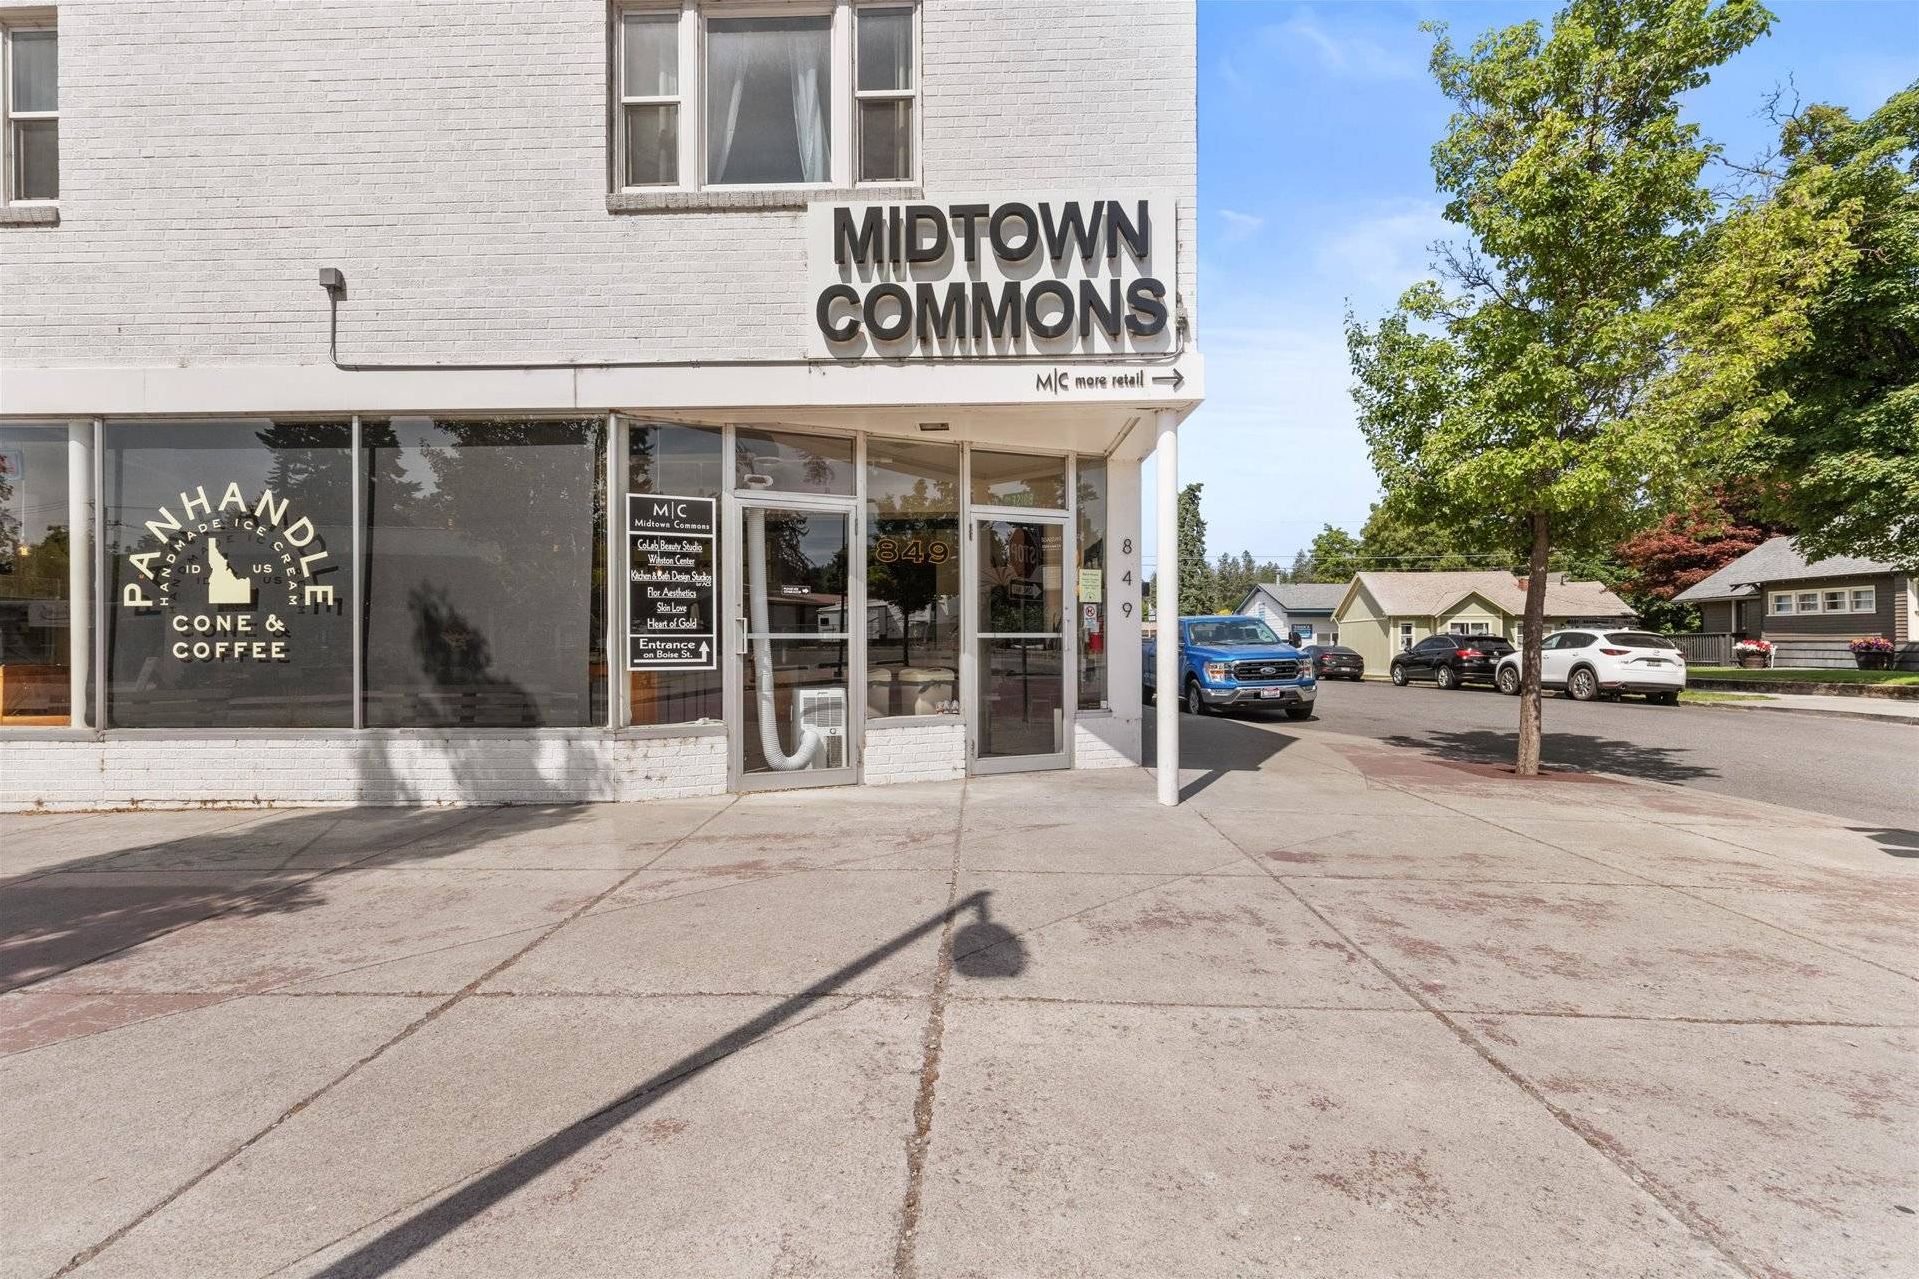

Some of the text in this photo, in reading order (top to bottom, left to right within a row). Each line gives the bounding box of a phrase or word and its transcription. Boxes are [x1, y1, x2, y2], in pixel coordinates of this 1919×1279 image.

[833, 200, 1149, 264] MIDTOWN
[815, 277, 1168, 341] COMMONS
[1075, 376, 1107, 389] more
[1112, 369, 1144, 388] retail
[634, 519, 710, 530] Midtown Commons
[123, 482, 334, 607] PANHANDLE
[637, 539, 703, 552] CoLab Beauty Studio
[876, 539, 950, 564] 849
[160, 518, 298, 606] HANDMADE ICE CREAM
[675, 555, 695, 565] Center
[185, 564, 273, 574] ID US
[631, 569, 652, 580] Kitchen
[652, 571, 657, 580] &
[672, 571, 690, 582] Design
[691, 571, 712, 582] Studios
[647, 587, 697, 598] Flor Aesthetics
[657, 602, 687, 612] Skin Love
[172, 613, 286, 632] CONE &
[647, 618, 697, 628] Heart of Gold
[172, 642, 286, 658] COFFEE
[640, 638, 696, 649] Entrance
[656, 650, 679, 658] Boise
[681, 650, 693, 658] St.
